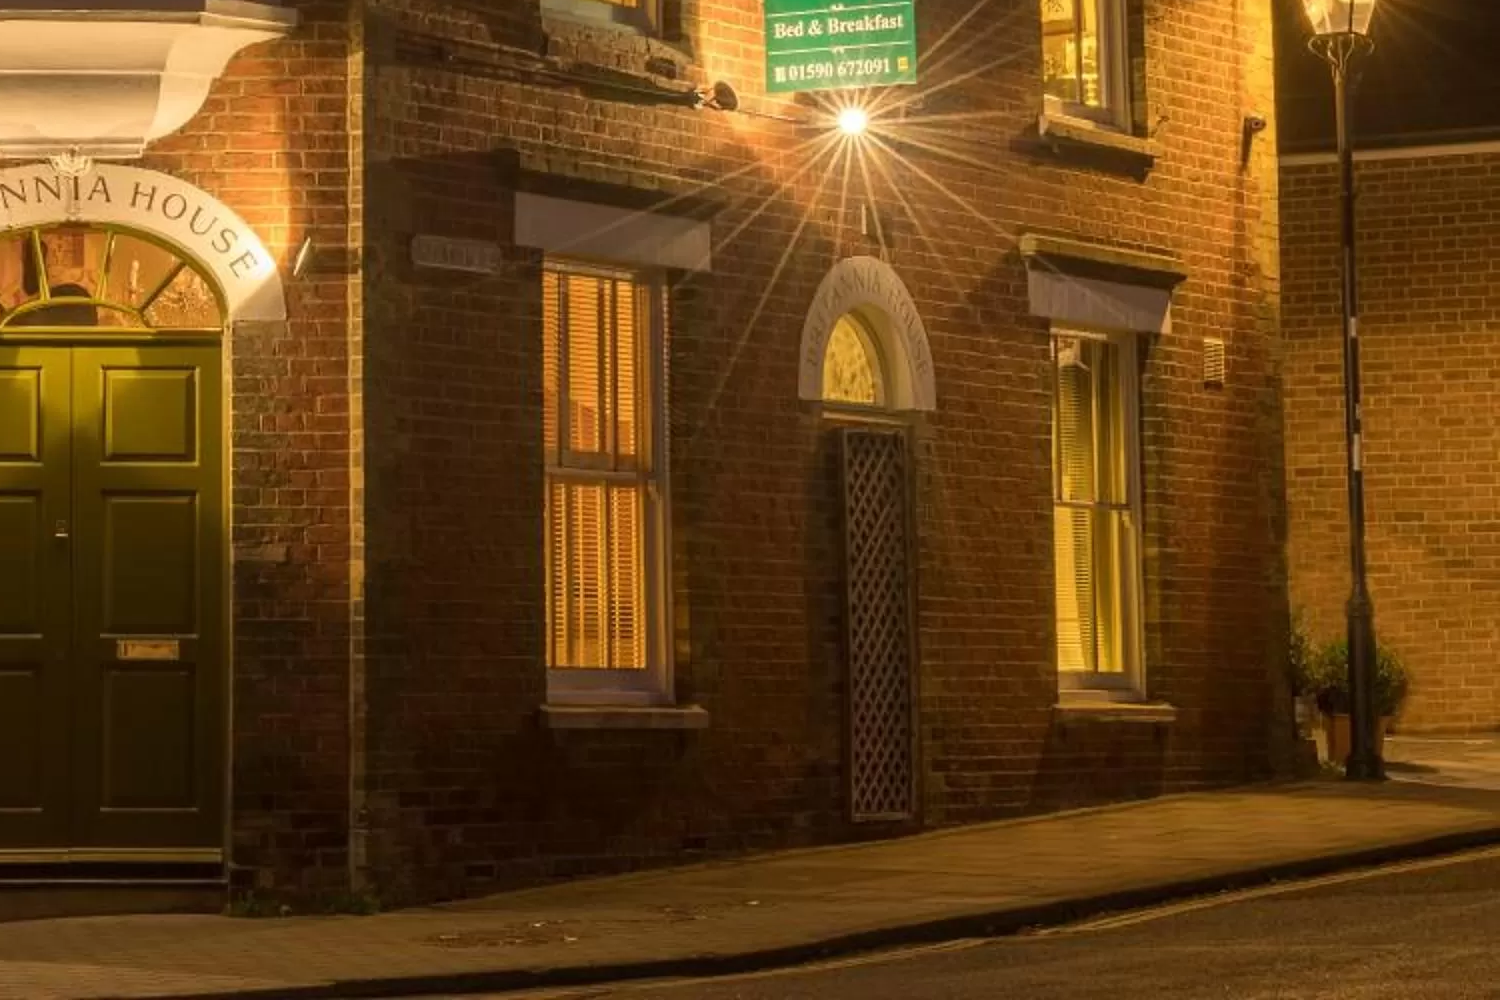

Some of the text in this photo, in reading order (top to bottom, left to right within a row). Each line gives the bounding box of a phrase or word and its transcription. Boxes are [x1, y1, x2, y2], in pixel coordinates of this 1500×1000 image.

[773, 13, 904, 39] Bed & Breakfast
[788, 57, 890, 81] 01590 672091
[130, 180, 259, 279] HOUSE
